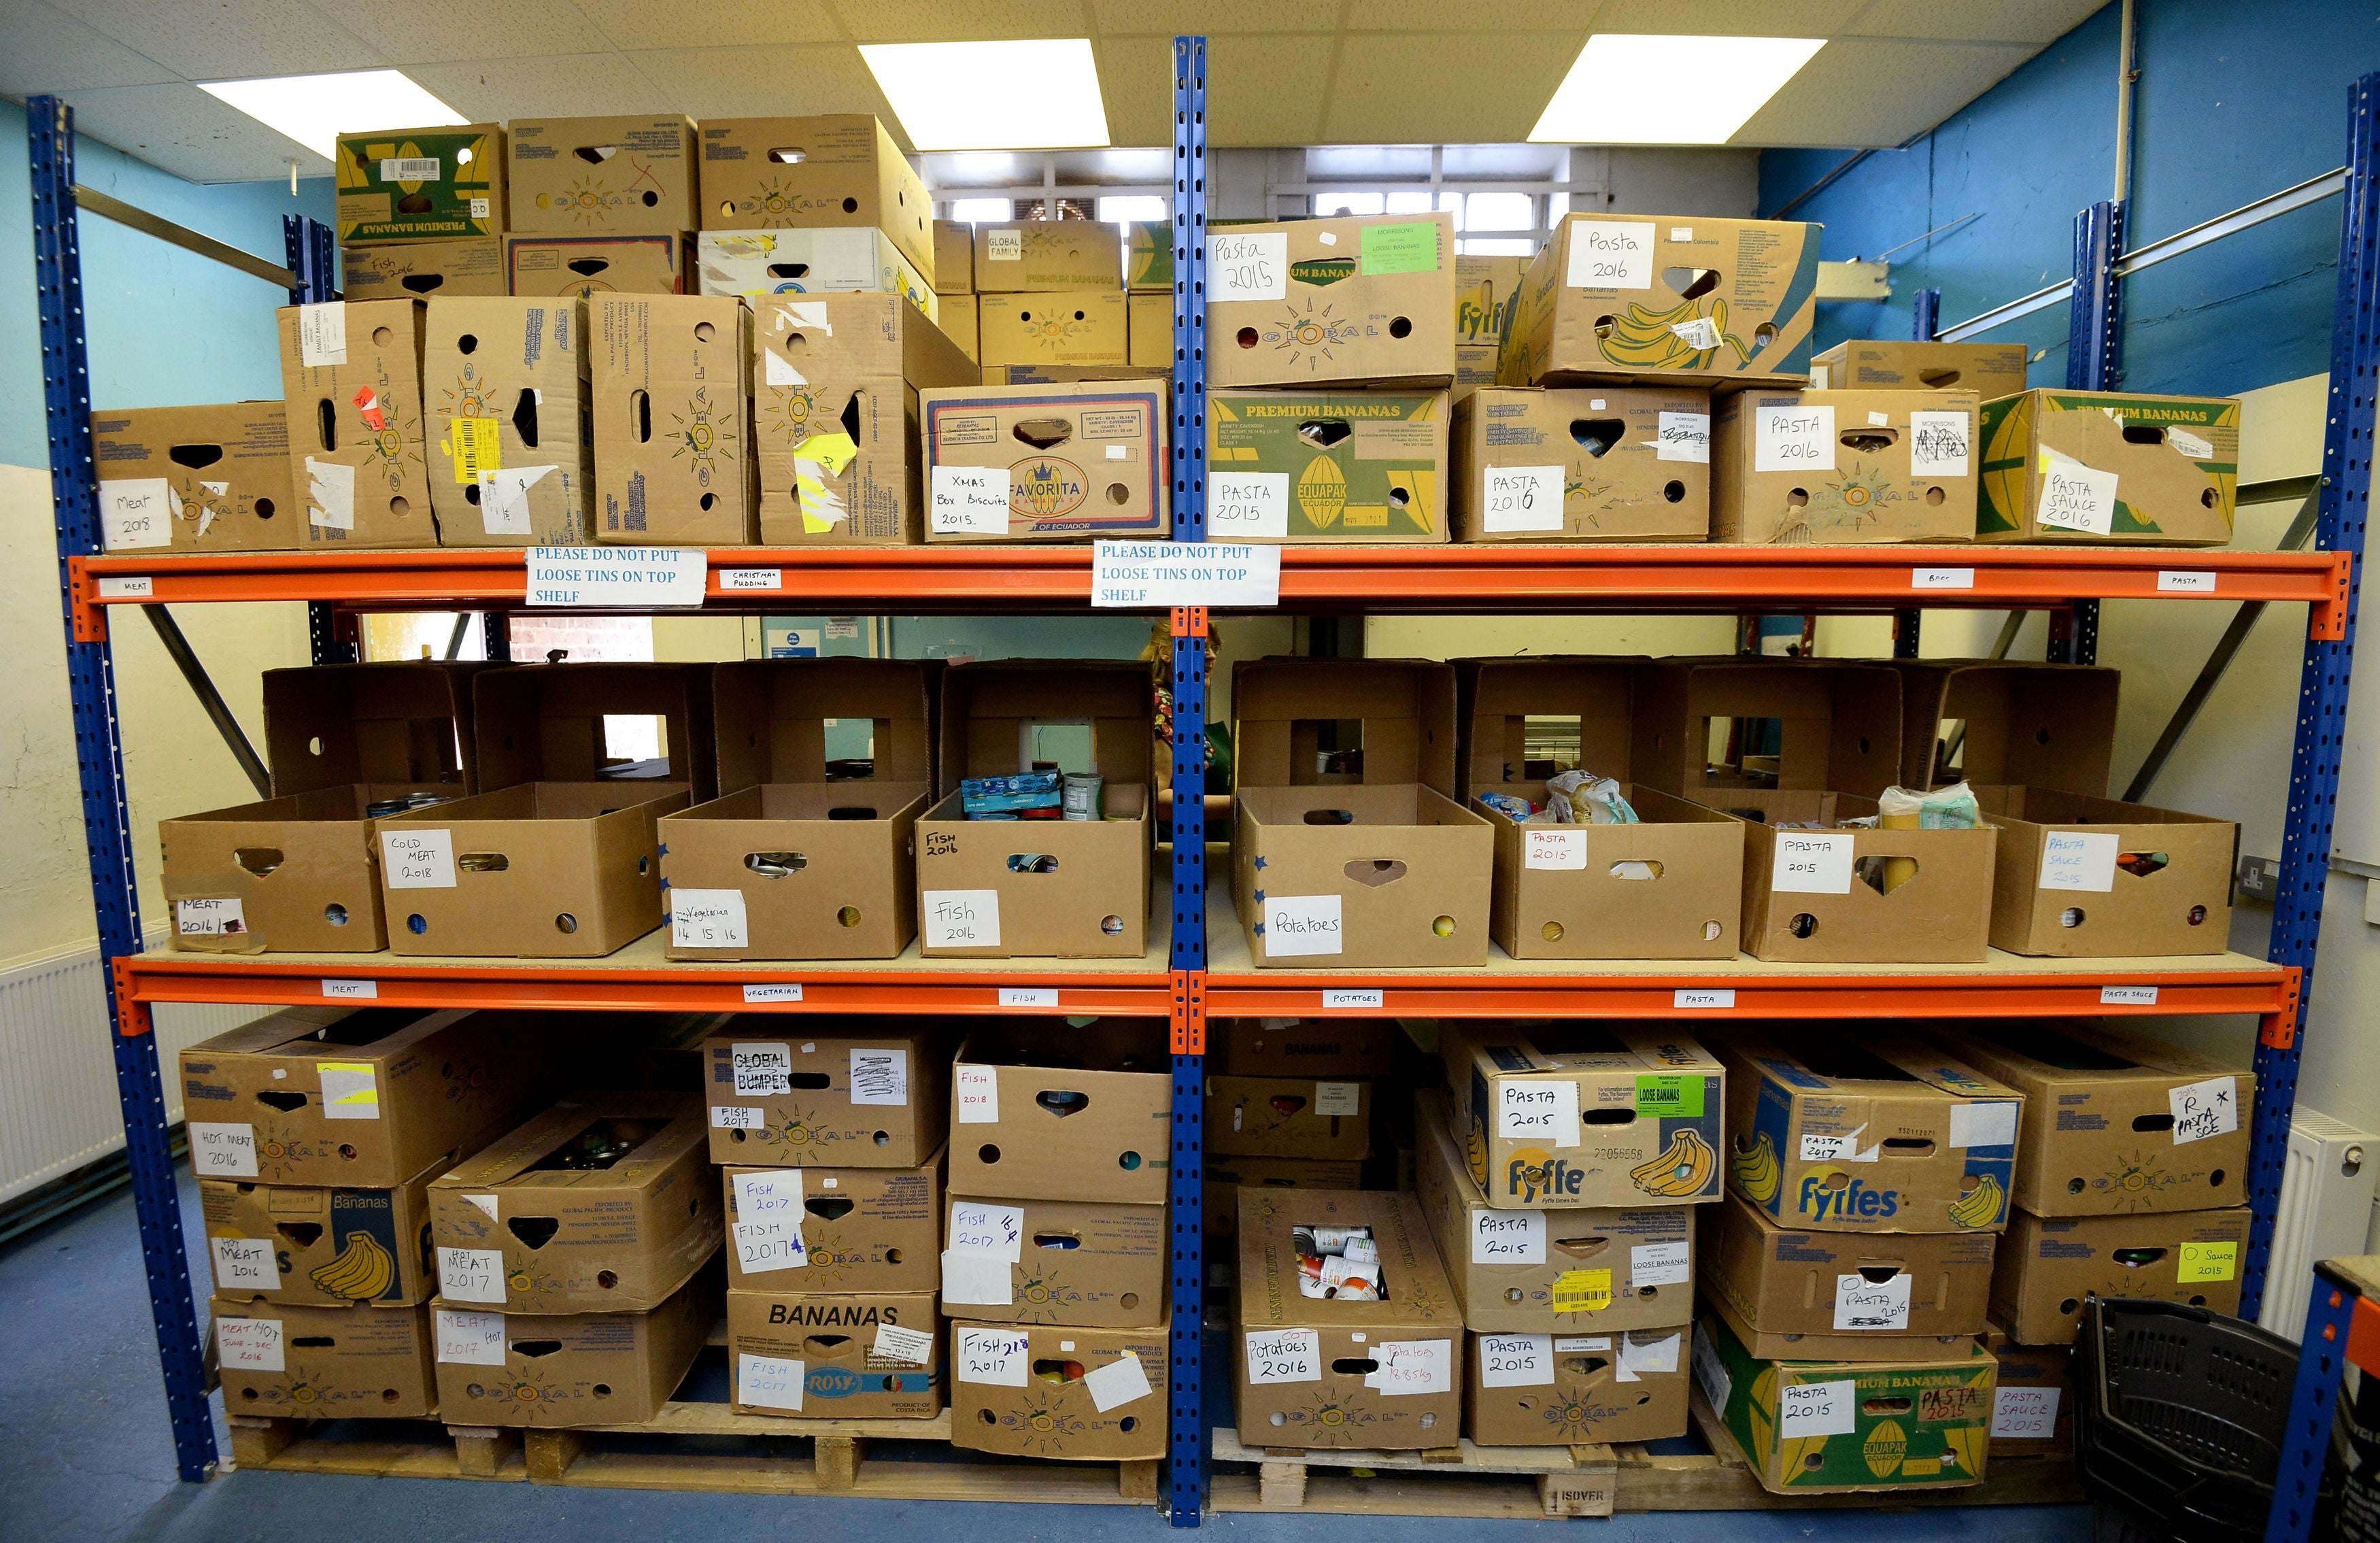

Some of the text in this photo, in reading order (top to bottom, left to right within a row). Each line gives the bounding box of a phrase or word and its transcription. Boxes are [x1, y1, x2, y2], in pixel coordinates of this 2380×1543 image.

[363, 222, 466, 233] PREMIUM BANANAS
[1590, 232, 1638, 250] Pasta
[991, 248, 1018, 256] FAMILY
[1216, 237, 1264, 260] Pasta
[372, 258, 395, 271] Fish
[1594, 262, 1627, 277] 2016
[390, 268, 413, 277] 2016
[1226, 262, 1273, 289] 2015
[1246, 406, 1400, 416] PREMIUM BANANAS
[2143, 410, 2207, 422] BANANAS
[1771, 416, 1819, 433] PASTA
[1780, 445, 1818, 458] 2016
[952, 477, 985, 487] XMAS
[1494, 476, 1540, 491] PASTA
[2052, 474, 2092, 496] PASTA
[1223, 486, 1270, 499] PASTA
[1297, 484, 1346, 498] EQUAPAK
[118, 496, 150, 509] Meat
[937, 494, 1006, 505] Box Biscuits
[1491, 488, 1533, 511] 2016
[2047, 494, 2096, 511] SAUCE
[1217, 505, 1259, 520] 2015
[2046, 508, 2090, 527] 2016
[122, 520, 150, 532] 2018
[536, 549, 679, 562] PLEASE DO NOT PUT
[1102, 545, 1252, 559] PLEASE DO NOT PUT
[536, 569, 676, 583] LOOSE TINS ON TOP
[1102, 568, 1247, 581] LOOSE TINS ON TOP
[125, 582, 146, 591] MEAT
[535, 590, 579, 603] SHELF
[1101, 589, 1146, 601] SHELF
[391, 838, 420, 848] COLD
[926, 832, 955, 845] FISH
[1531, 833, 1565, 843] PASTA
[2048, 838, 2085, 849] PASTA
[927, 845, 957, 855] 2016
[1785, 841, 1831, 851] PASTA
[409, 850, 435, 860] MEAT
[1533, 849, 1571, 860] 2015
[2049, 855, 2082, 864] SAUCE
[402, 866, 431, 878] 2018
[1789, 864, 1816, 872] 2015
[2054, 872, 2081, 883] 2015
[184, 900, 222, 909] MEAT
[687, 906, 728, 922] Vegetarian
[934, 902, 974, 921] Fish
[1276, 912, 1338, 933] Potatoes
[677, 928, 736, 940] 14 15 16
[947, 927, 975, 940] 2016
[745, 988, 798, 997] VEGETARIAN
[1333, 994, 1377, 1003] POTATOES
[1686, 995, 1715, 1003] PASTA
[962, 1072, 987, 1083] FISH
[1506, 1089, 1555, 1104] PASTA
[1639, 1089, 1680, 1102] LOOSE BANANAS
[722, 1108, 748, 1117] FISH
[724, 1118, 749, 1126] 2017
[1509, 1113, 1554, 1126] 2015
[203, 1132, 251, 1147] HOT MEAT
[1808, 1147, 1837, 1159] 2017
[211, 1153, 237, 1166] 2016
[747, 1183, 773, 1196] FISH
[334, 1198, 388, 1208] Bananas
[757, 1200, 788, 1210] 2017
[1799, 1177, 1897, 1221] fyffes
[958, 1210, 985, 1225] FISH
[739, 1224, 779, 1238] FISH
[1480, 1218, 1527, 1234] PASTA
[222, 1238, 239, 1249] HOT
[959, 1233, 993, 1246] 2017
[221, 1248, 262, 1259] MEAT
[745, 1241, 787, 1262] 2017
[1486, 1242, 1527, 1254] 2015
[452, 1250, 471, 1259] HOT
[2205, 1250, 2233, 1259] Sauce
[449, 1257, 490, 1270] MEAT
[1656, 1258, 1687, 1266] BANANAS
[233, 1265, 258, 1276] 2016
[446, 1275, 490, 1292] 2017
[1846, 1294, 1890, 1305] PASTA
[769, 1304, 898, 1325] BANANAS
[1882, 1304, 1906, 1317] 2015
[222, 1322, 279, 1342] MEAT HOT
[443, 1317, 500, 1344] MEAT HOT
[223, 1339, 244, 1348] JUNE
[446, 1342, 479, 1355] 2017
[964, 1334, 1000, 1355] FISH
[1486, 1340, 1533, 1352] PASTA
[751, 1363, 787, 1374] FISH
[970, 1360, 1005, 1372] 2017
[1261, 1361, 1307, 1377] 2016
[1489, 1357, 1537, 1371] 2015
[750, 1379, 785, 1390] 2017
[1786, 1387, 1826, 1399] PASTA
[1922, 1389, 1976, 1409] PASTA
[2001, 1393, 2042, 1403] PASTA
[1787, 1404, 1832, 1419] 2015
[1928, 1406, 1965, 1420] 2015
[1999, 1404, 2047, 1415] SAUCE
[1998, 1419, 2041, 1431] 2015
[1864, 1441, 1907, 1453] EQUAPAK
[1562, 1491, 1603, 1501] ISOVER
